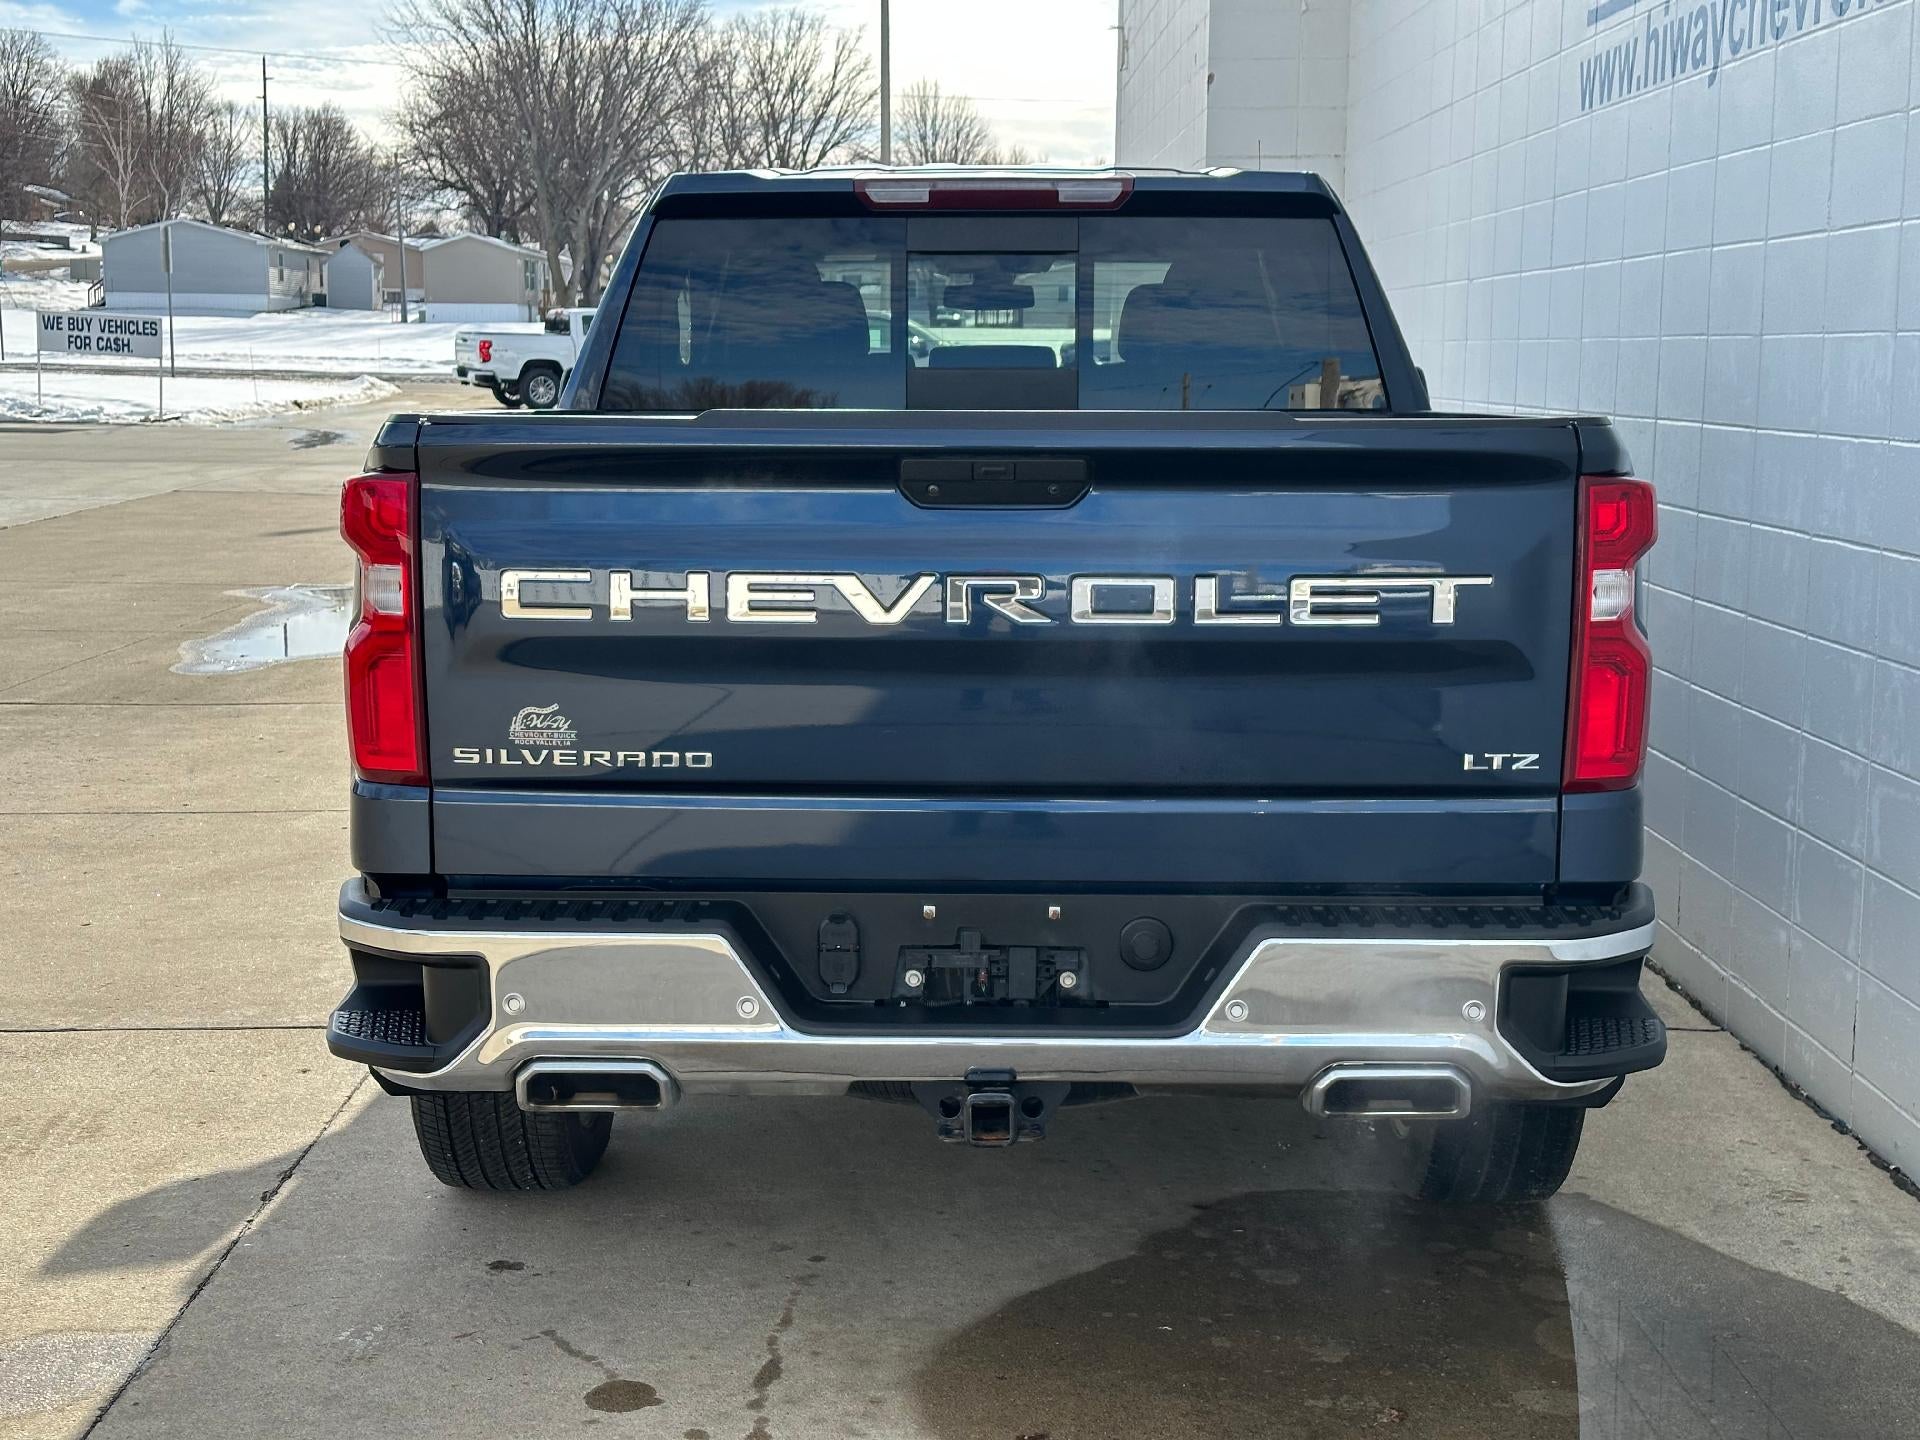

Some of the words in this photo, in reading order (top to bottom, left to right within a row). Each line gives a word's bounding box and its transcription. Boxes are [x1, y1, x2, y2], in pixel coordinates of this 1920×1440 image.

[42, 314, 63, 331] WE
[67, 317, 93, 332] BUY
[98, 318, 158, 337] VEHICLES
[67, 335, 92, 351] FOR
[500, 569, 1493, 626] CHEVROLET
[452, 747, 713, 768] SILVERADO
[1463, 752, 1540, 771] LTZ
